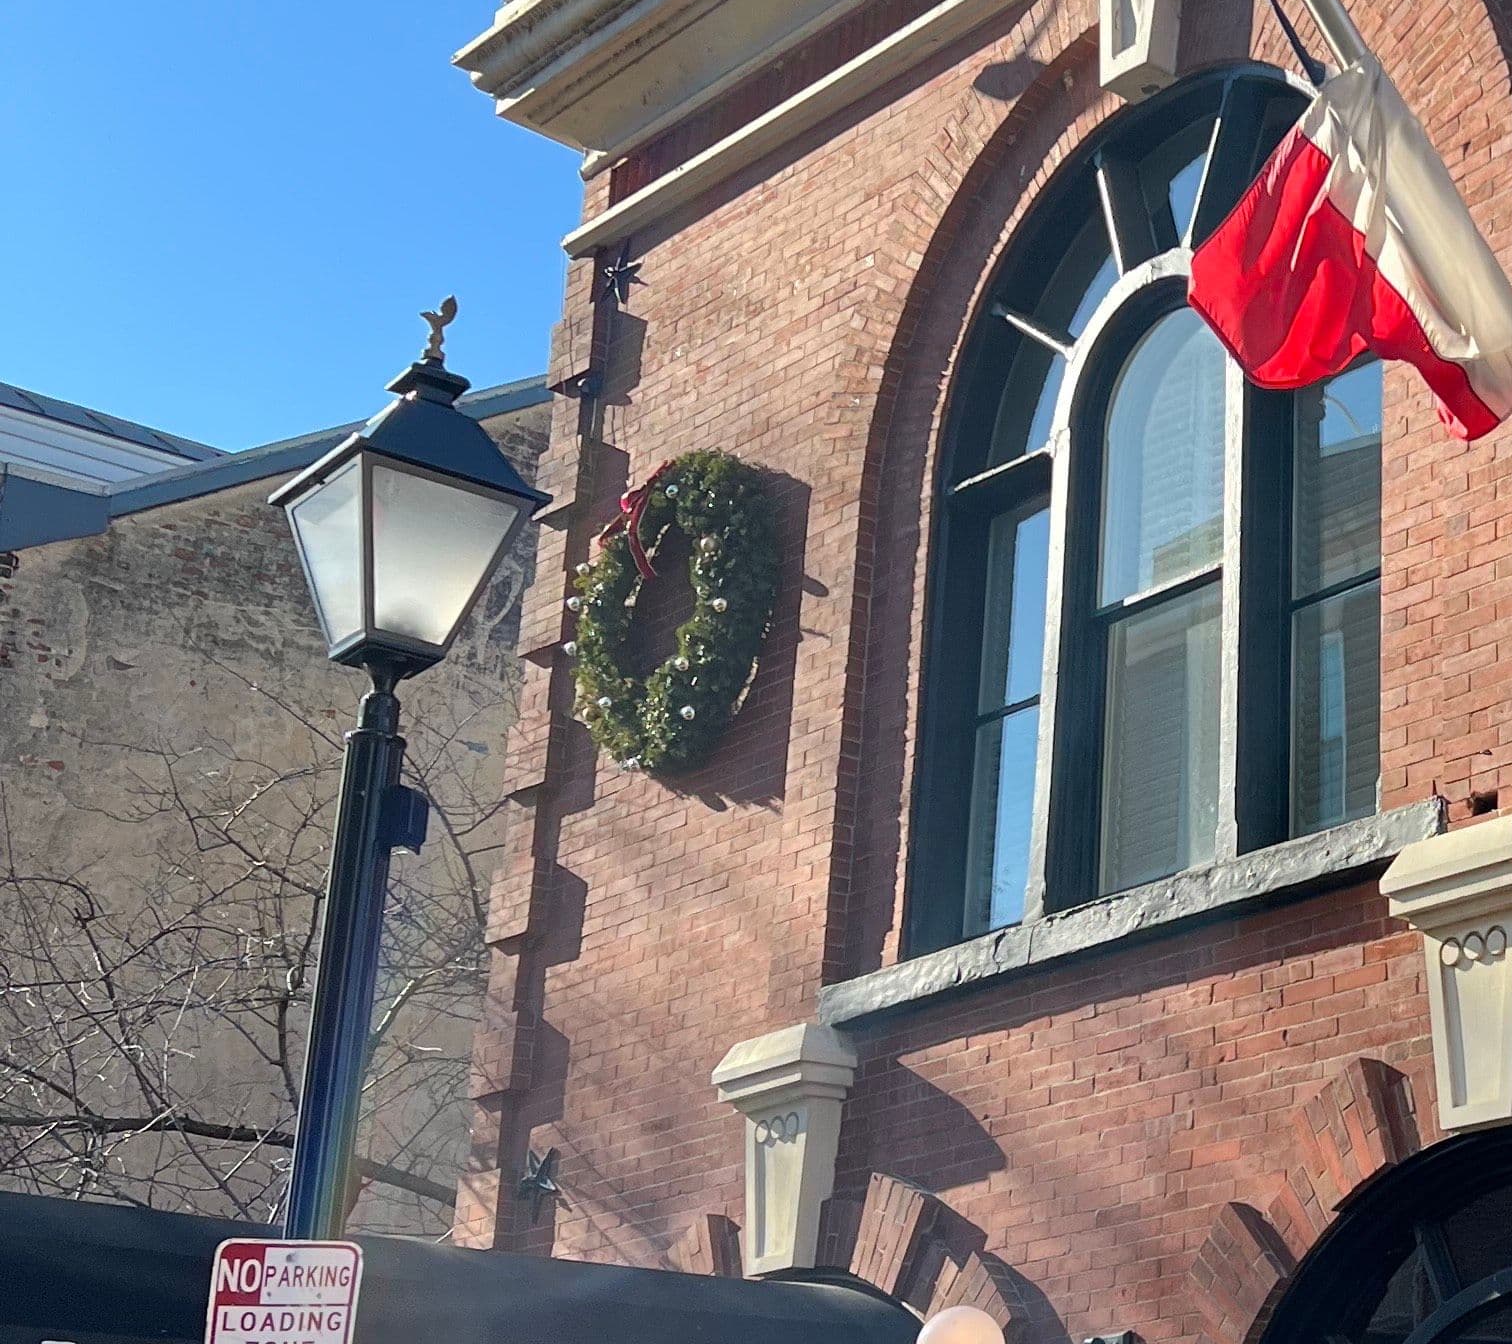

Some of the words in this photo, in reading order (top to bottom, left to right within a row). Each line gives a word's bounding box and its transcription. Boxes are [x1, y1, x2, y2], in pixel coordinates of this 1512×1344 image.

[217, 1258, 262, 1294] NO
[264, 1265, 351, 1288] PARKING
[222, 1311, 342, 1333] LOADING
